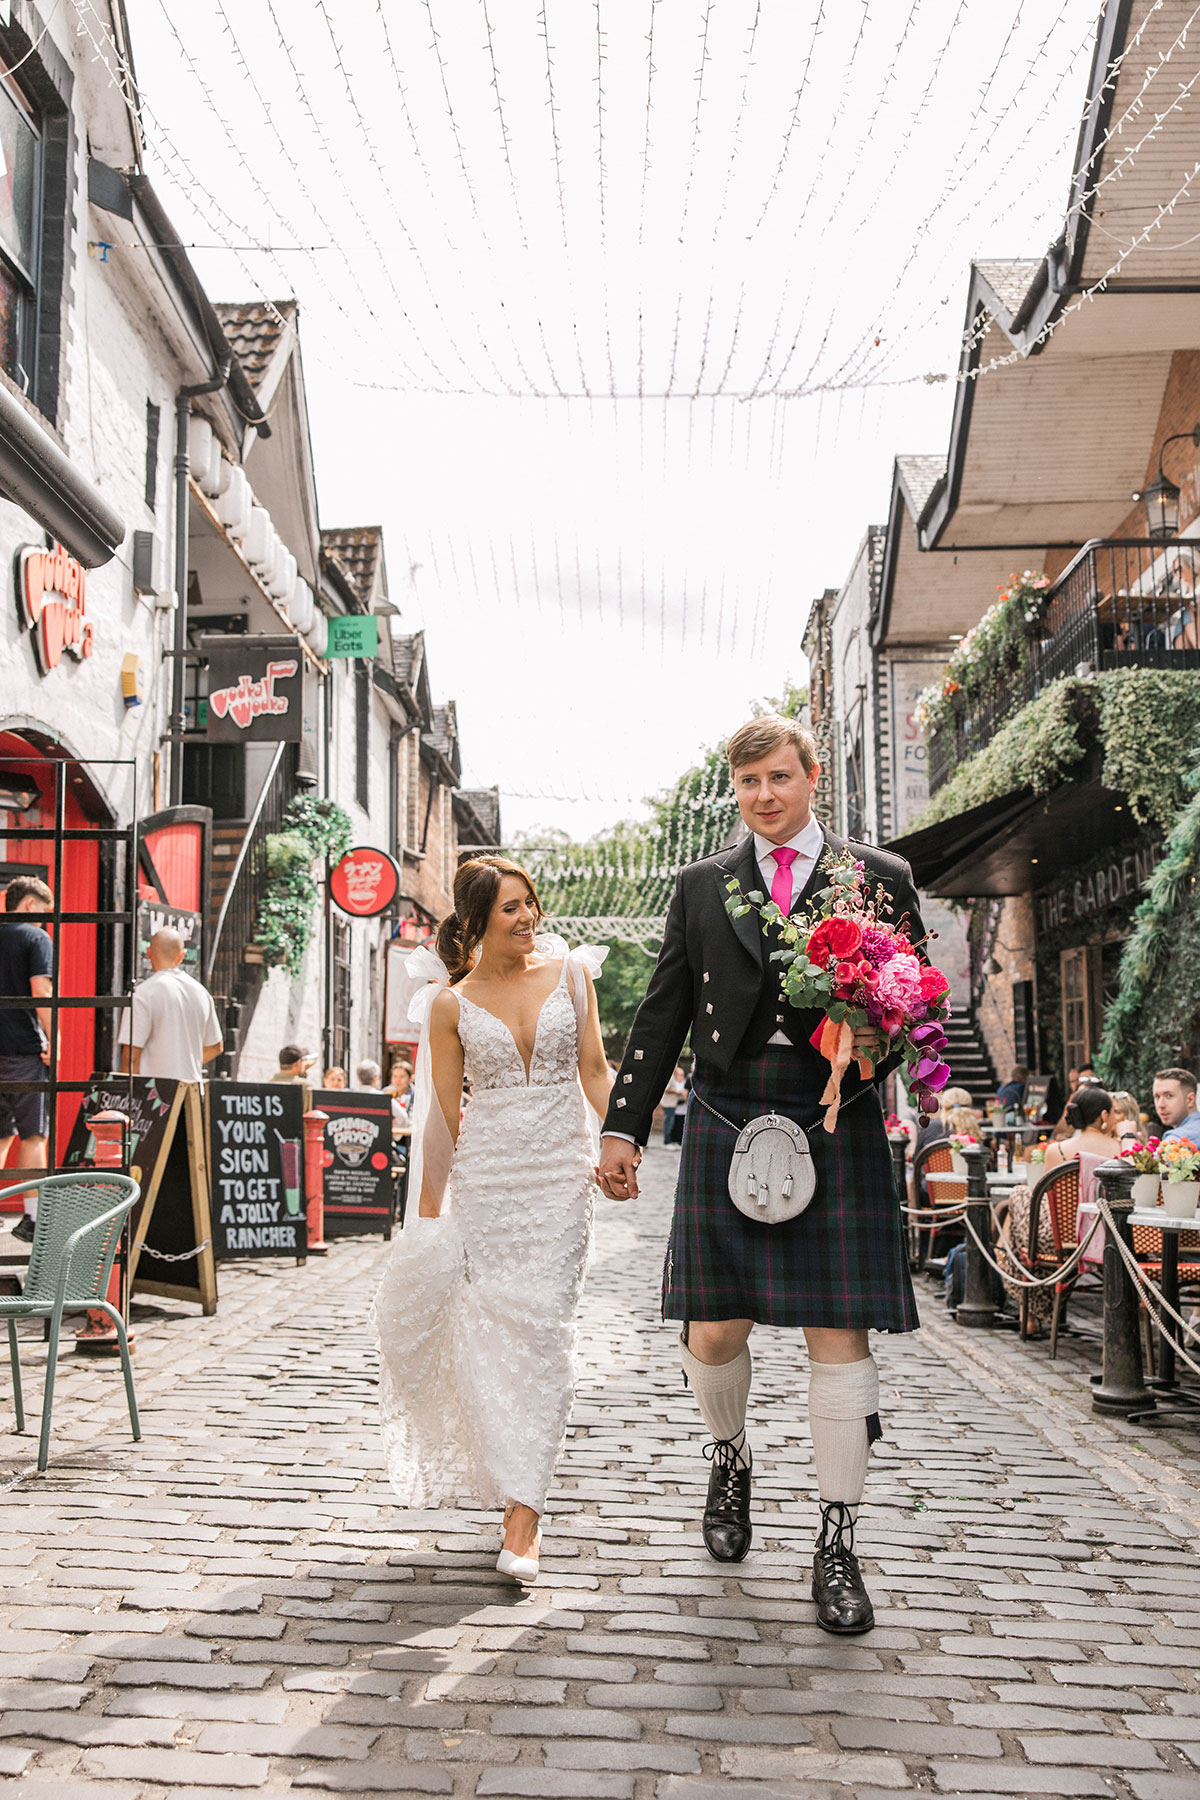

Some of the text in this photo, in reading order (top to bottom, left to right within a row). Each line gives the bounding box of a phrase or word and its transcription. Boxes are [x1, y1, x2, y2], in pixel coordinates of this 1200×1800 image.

[334, 630, 362, 640] Uber
[334, 641, 363, 651] Eats
[904, 745, 928, 761] FO
[1040, 889, 1067, 931] THE
[221, 1095, 284, 1117] THIS IS
[217, 1120, 267, 1144] YOUR
[327, 1117, 379, 1138] RAMEN
[219, 1147, 269, 1174] SIGN
[218, 1178, 280, 1201] TO GET
[220, 1201, 281, 1224] A JOLLY
[226, 1226, 296, 1249] RANCHER
